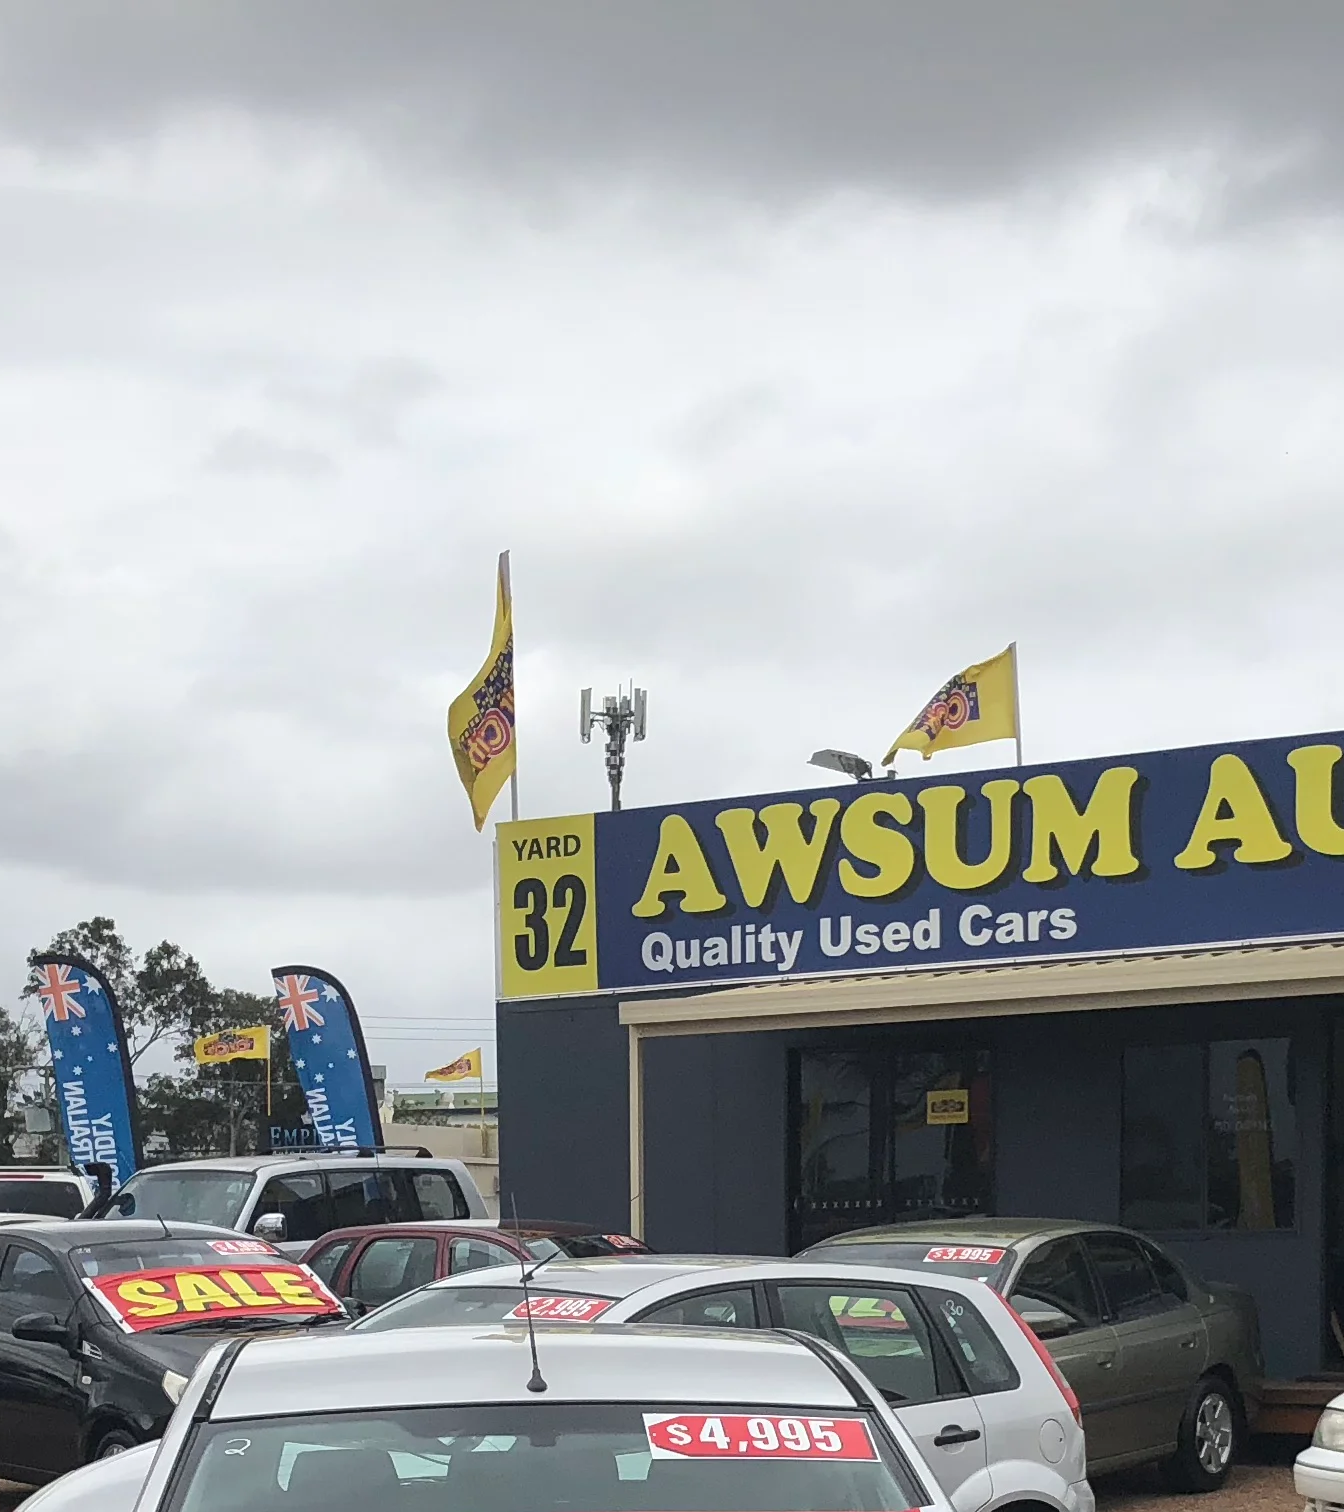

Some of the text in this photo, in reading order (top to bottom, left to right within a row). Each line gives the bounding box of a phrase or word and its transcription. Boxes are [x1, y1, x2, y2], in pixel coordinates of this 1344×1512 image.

[511, 833, 582, 863] YARD
[632, 767, 1142, 918] AWSUM
[513, 874, 588, 972] 32
[641, 904, 1078, 973] Quality Used Cars
[933, 1248, 993, 1261] $3,995
[117, 1270, 326, 1317] SALE
[223, 1437, 253, 1458] 2
[666, 1418, 844, 1454] $4,995
